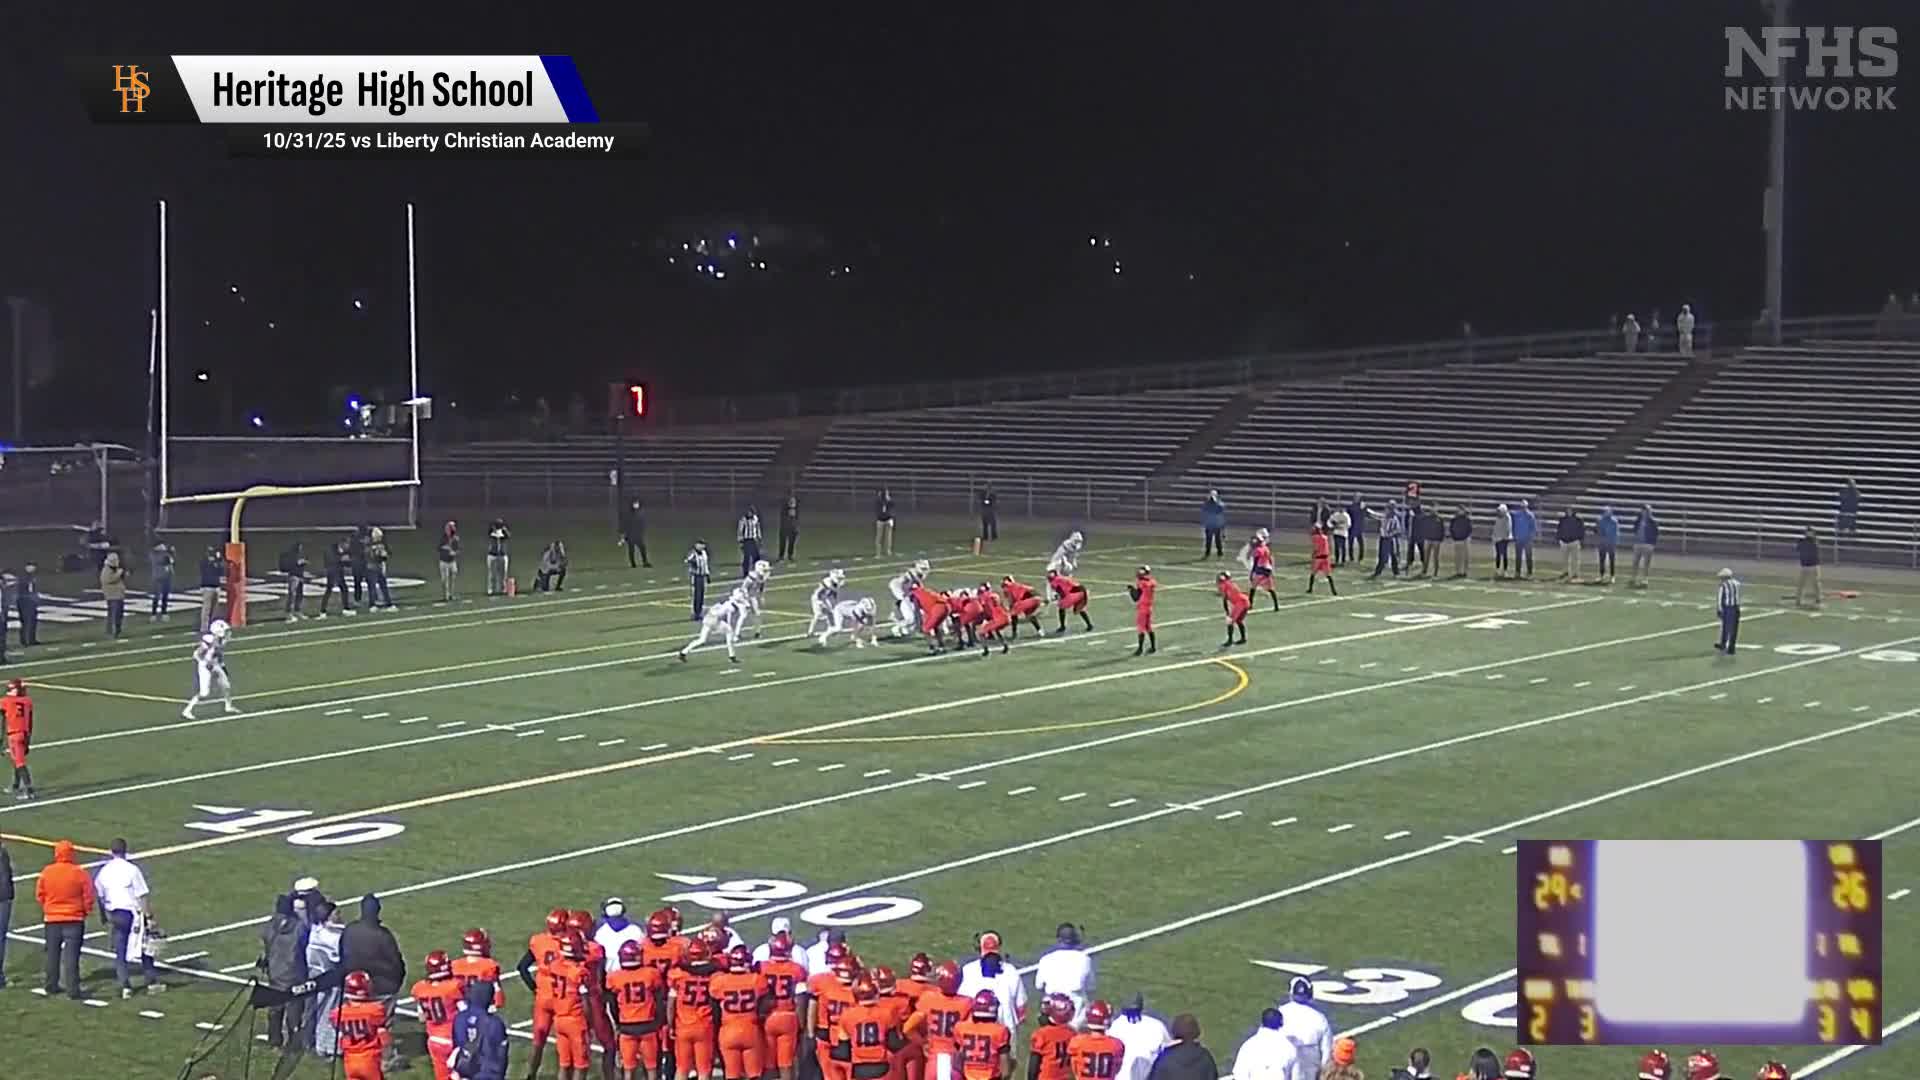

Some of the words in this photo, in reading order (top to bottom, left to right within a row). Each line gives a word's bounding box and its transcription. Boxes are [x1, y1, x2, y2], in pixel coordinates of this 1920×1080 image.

[623, 981, 646, 1004] 13
[724, 989, 757, 1013] 22
[341, 1018, 370, 1040] 44
[1578, 1003, 1596, 1041] 3
[1817, 1003, 1836, 1042] 3
[962, 1033, 993, 1063] 23
[1080, 1051, 1114, 1078] 30
